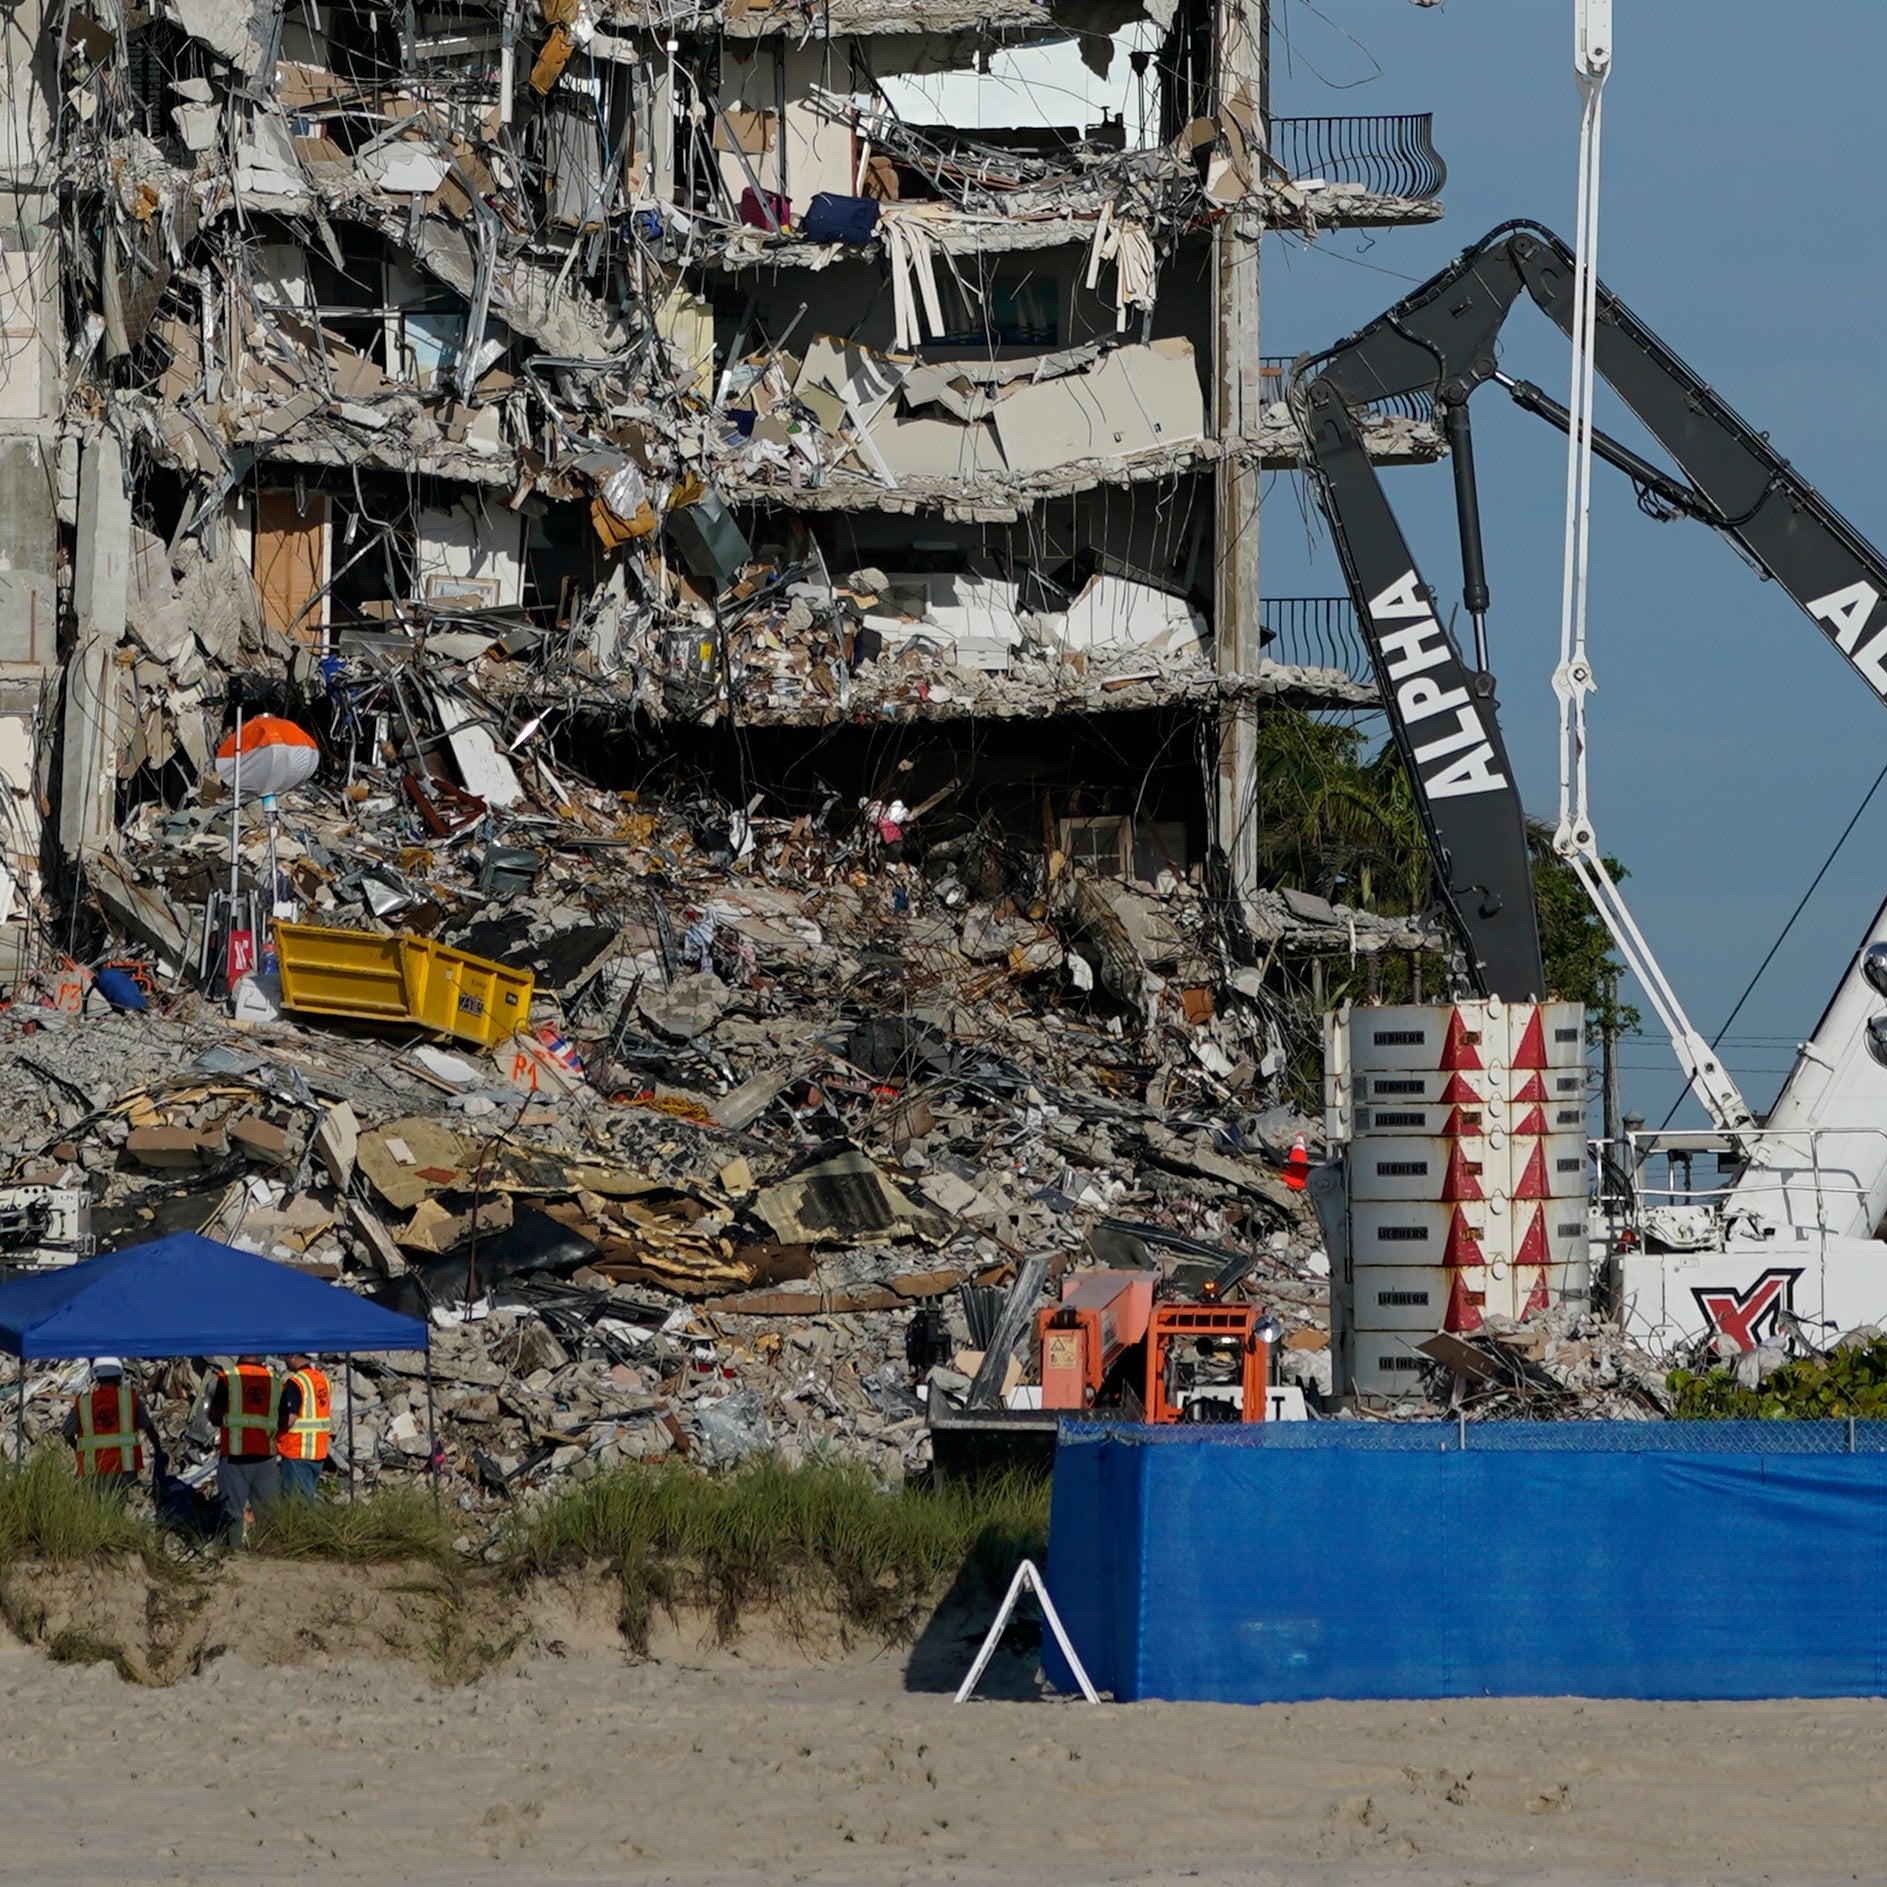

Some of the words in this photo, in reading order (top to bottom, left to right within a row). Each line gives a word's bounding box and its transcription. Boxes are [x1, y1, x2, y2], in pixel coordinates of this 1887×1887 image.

[1368, 568, 1509, 799] ALPHA
[1374, 1031, 1425, 1046] LIEBHERR
[512, 1053, 539, 1092] P1
[1374, 1080, 1425, 1094] LIEBHERR
[1375, 1112, 1425, 1127] LIEBHERR
[1377, 1161, 1428, 1176] LIEBHERR
[1378, 1226, 1428, 1241] LIEBHERR
[1378, 1291, 1429, 1306] LIEBHERR
